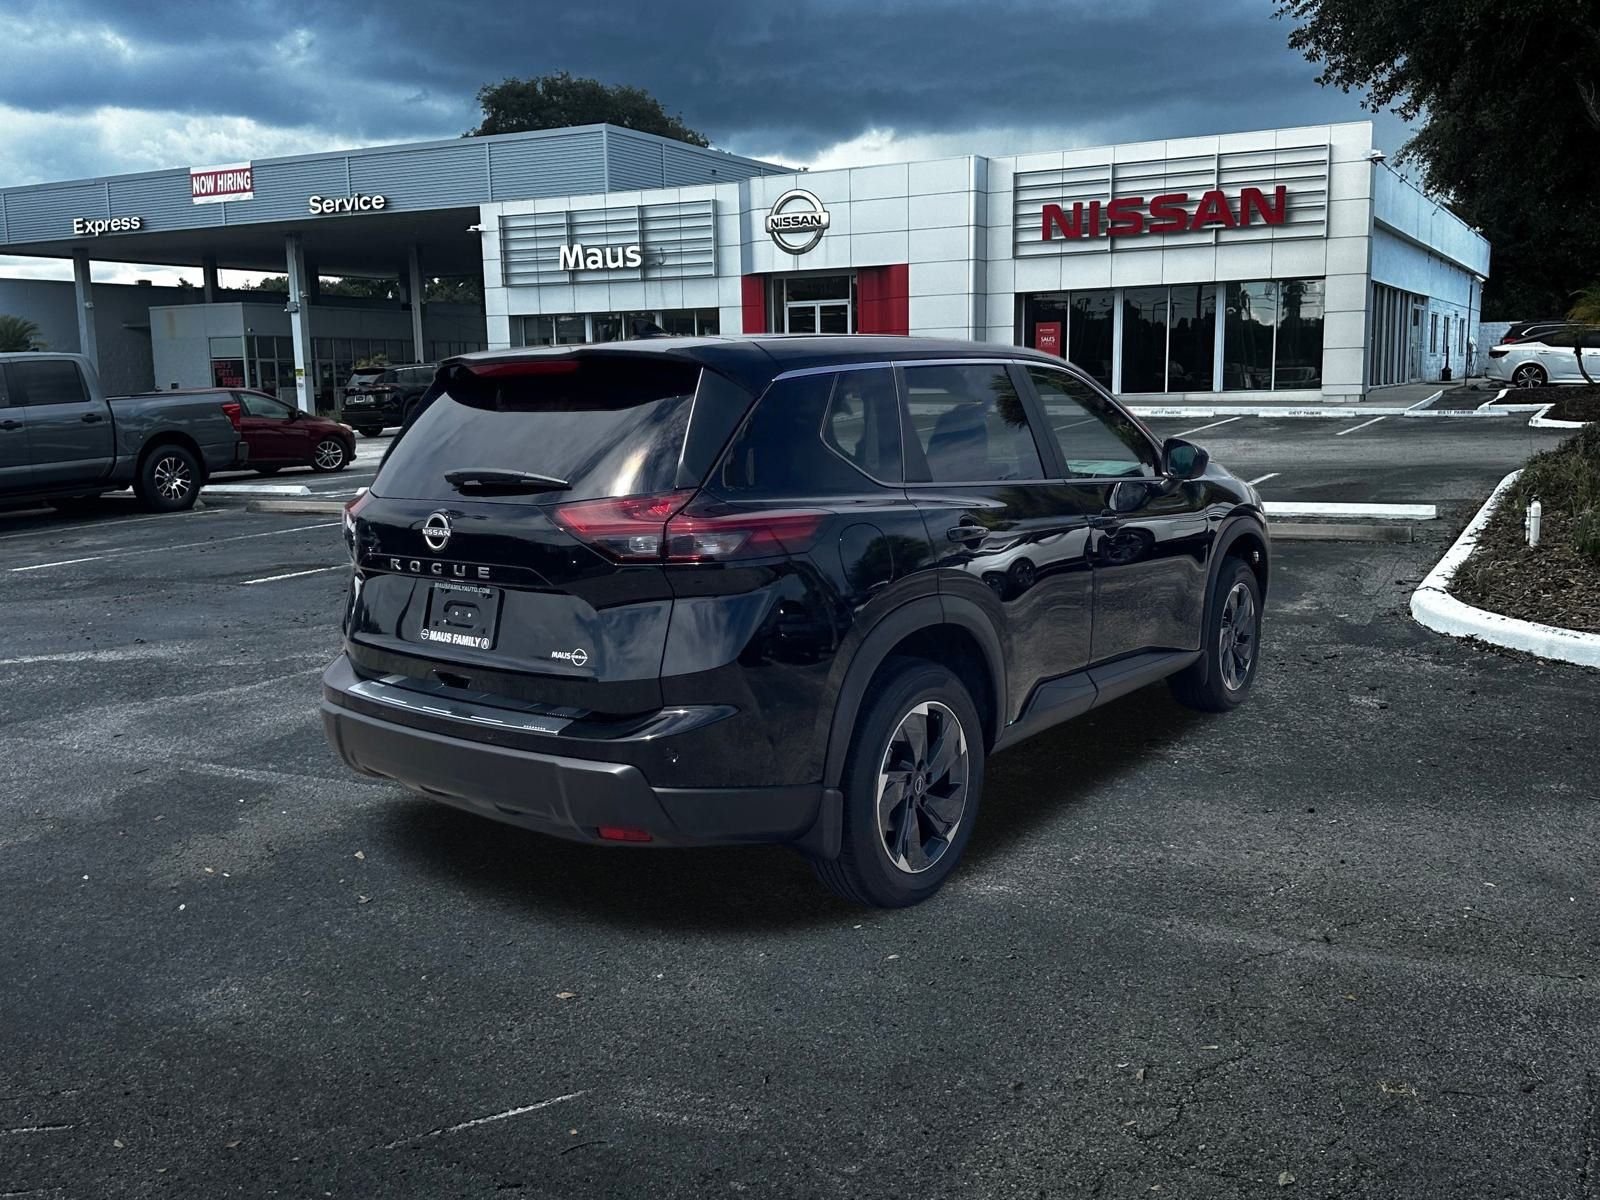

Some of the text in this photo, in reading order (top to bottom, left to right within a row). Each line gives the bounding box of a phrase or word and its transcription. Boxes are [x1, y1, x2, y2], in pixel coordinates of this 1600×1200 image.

[192, 170, 251, 195] NOW HIRING
[309, 192, 385, 215] Service
[1042, 185, 1287, 241] NISSAN
[73, 215, 141, 236] Express
[770, 214, 822, 230] NISSAN
[559, 243, 643, 271] Maus
[422, 528, 451, 537] NISSAN
[390, 558, 490, 579] ROGUE
[434, 582, 491, 594] MAUSFAMILYAUTO.COM
[429, 630, 482, 647] MAUS FAMILY
[551, 651, 571, 660] MAUS
